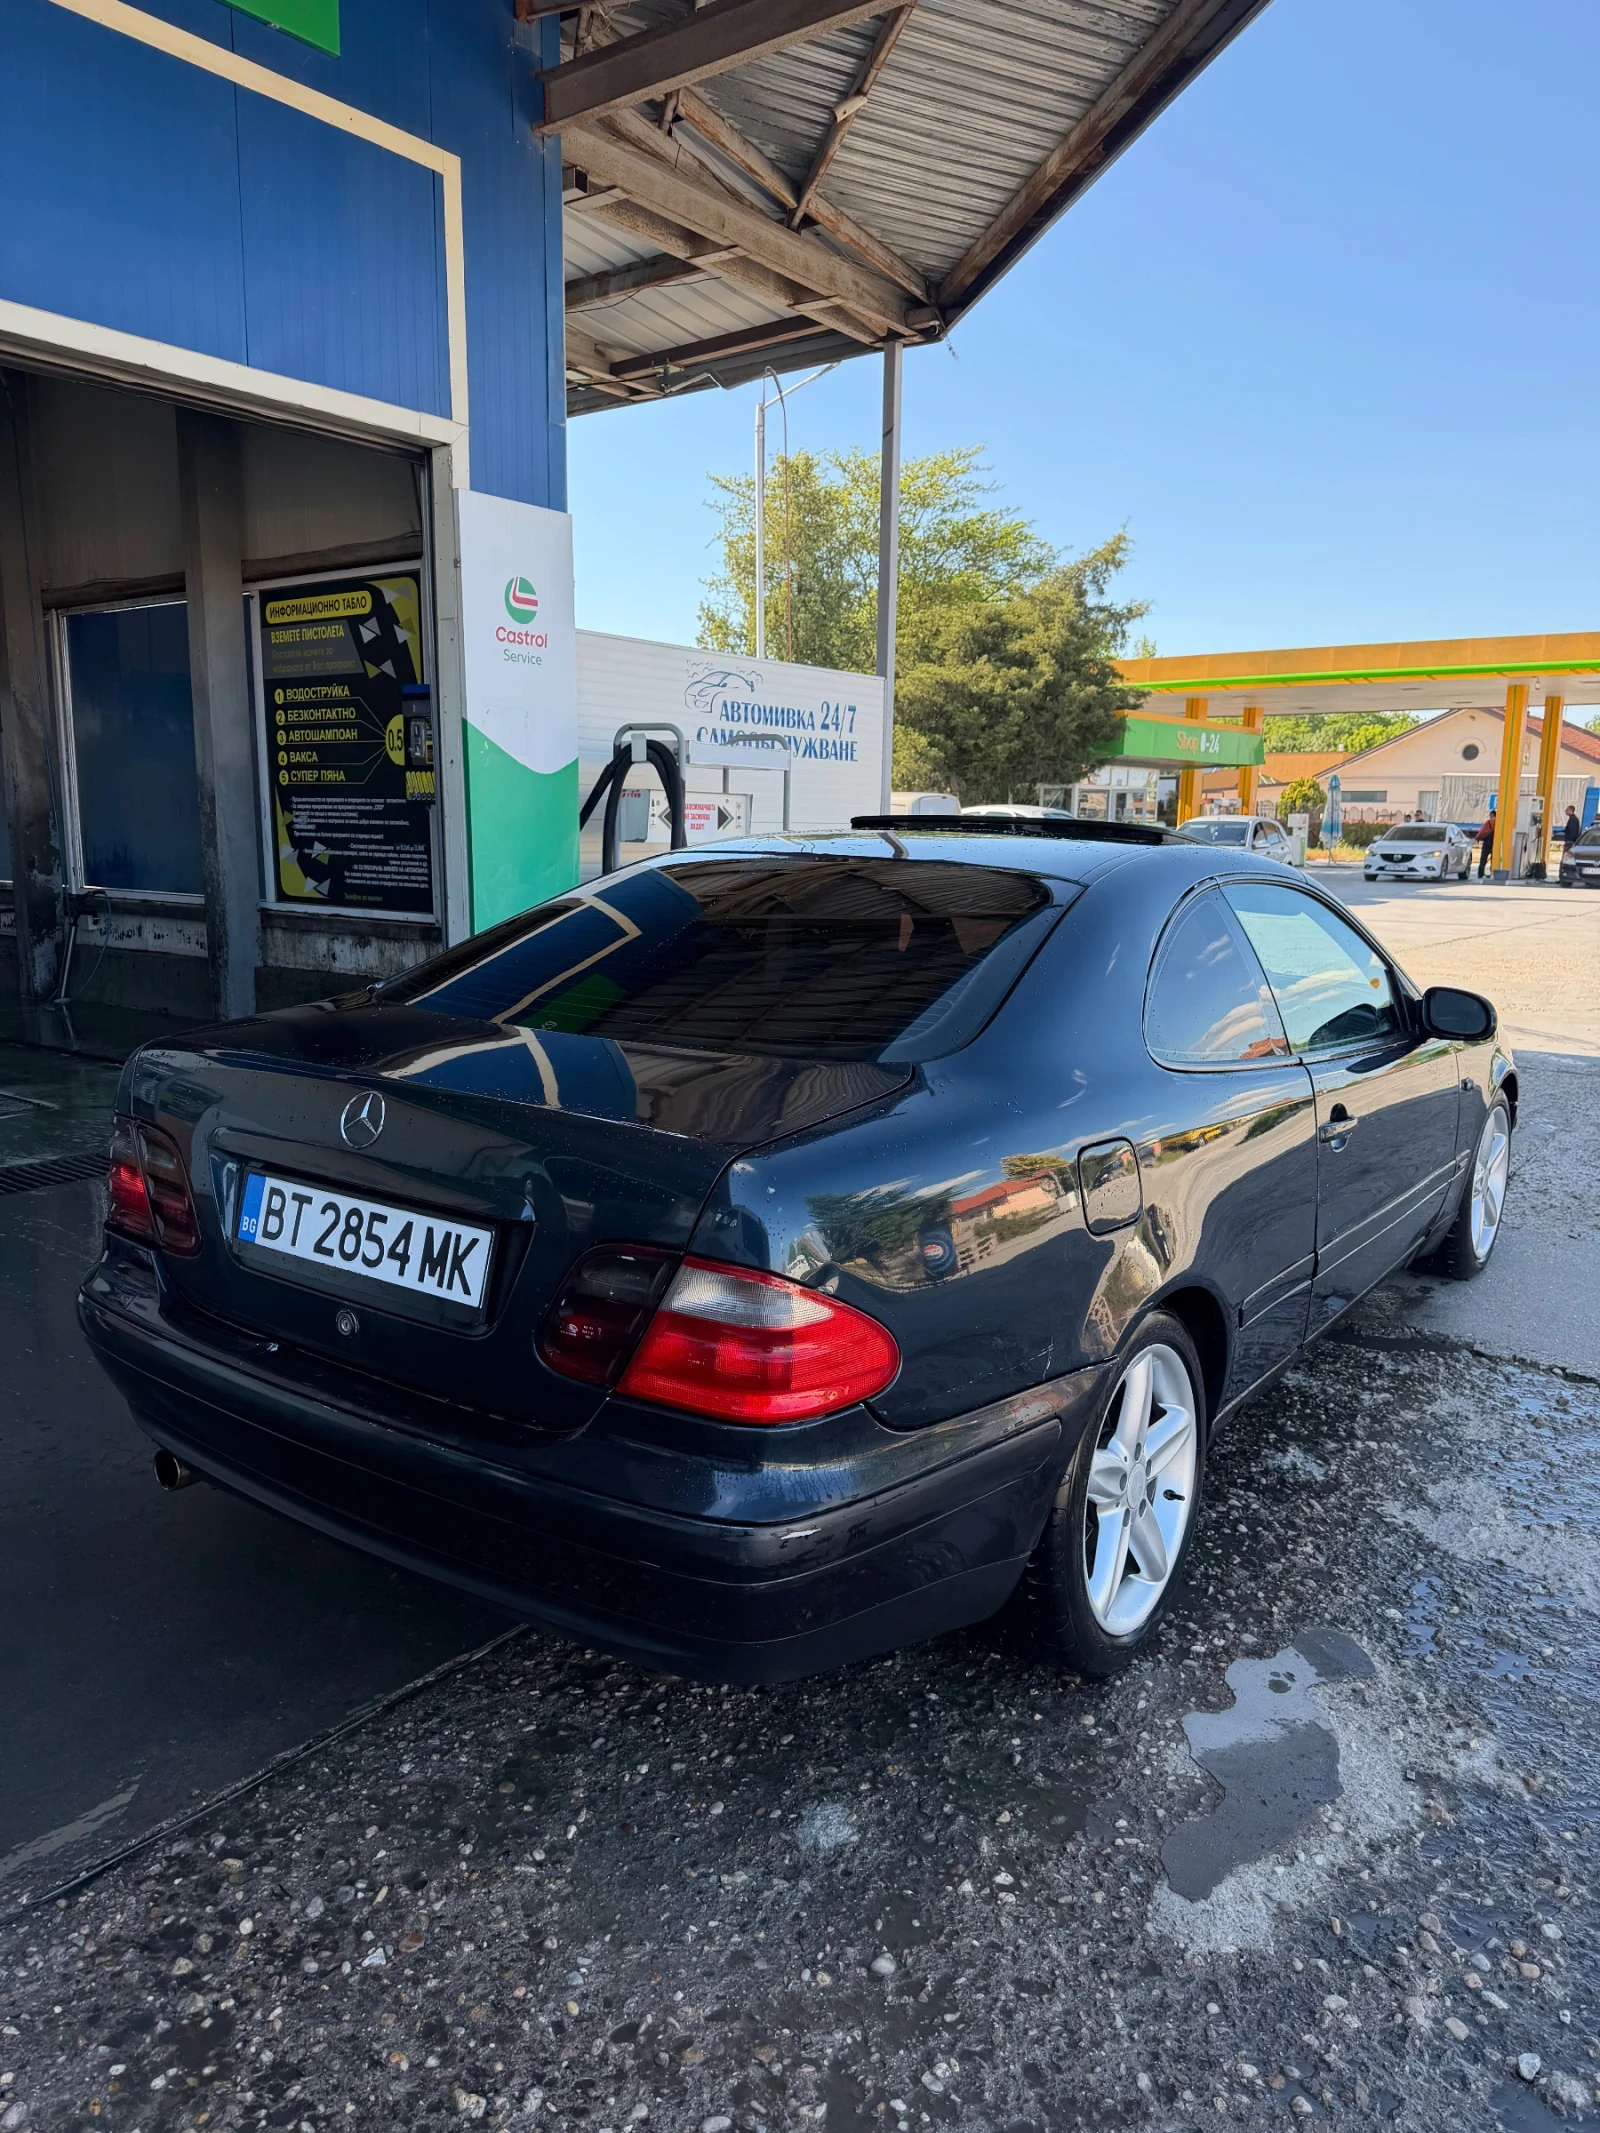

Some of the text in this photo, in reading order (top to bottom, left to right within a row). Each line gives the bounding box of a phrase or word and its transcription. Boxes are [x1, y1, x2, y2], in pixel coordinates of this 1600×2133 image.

[269, 595, 367, 619] ИНФОРМАЦИОННО ТАБЛО
[271, 625, 345, 644] ВЗЕМЕТЕ ПИСТОЛЕТА
[495, 626, 548, 648] Castrol
[503, 649, 542, 666] Service
[286, 683, 350, 701] ВОДОСТРУЙКА
[287, 707, 356, 721] БЕЗКОНТАКТНО
[719, 700, 857, 739] АВТОМИВКА 24/7
[288, 729, 358, 741] АВТОШАМПОАН
[1177, 731, 1220, 755] Shop 0-24
[289, 751, 318, 763] ВАКСА
[290, 770, 346, 782] СУПЕР ПЯНА
[241, 1216, 257, 1233] BG
[260, 1186, 480, 1296] BT 2854 MK
